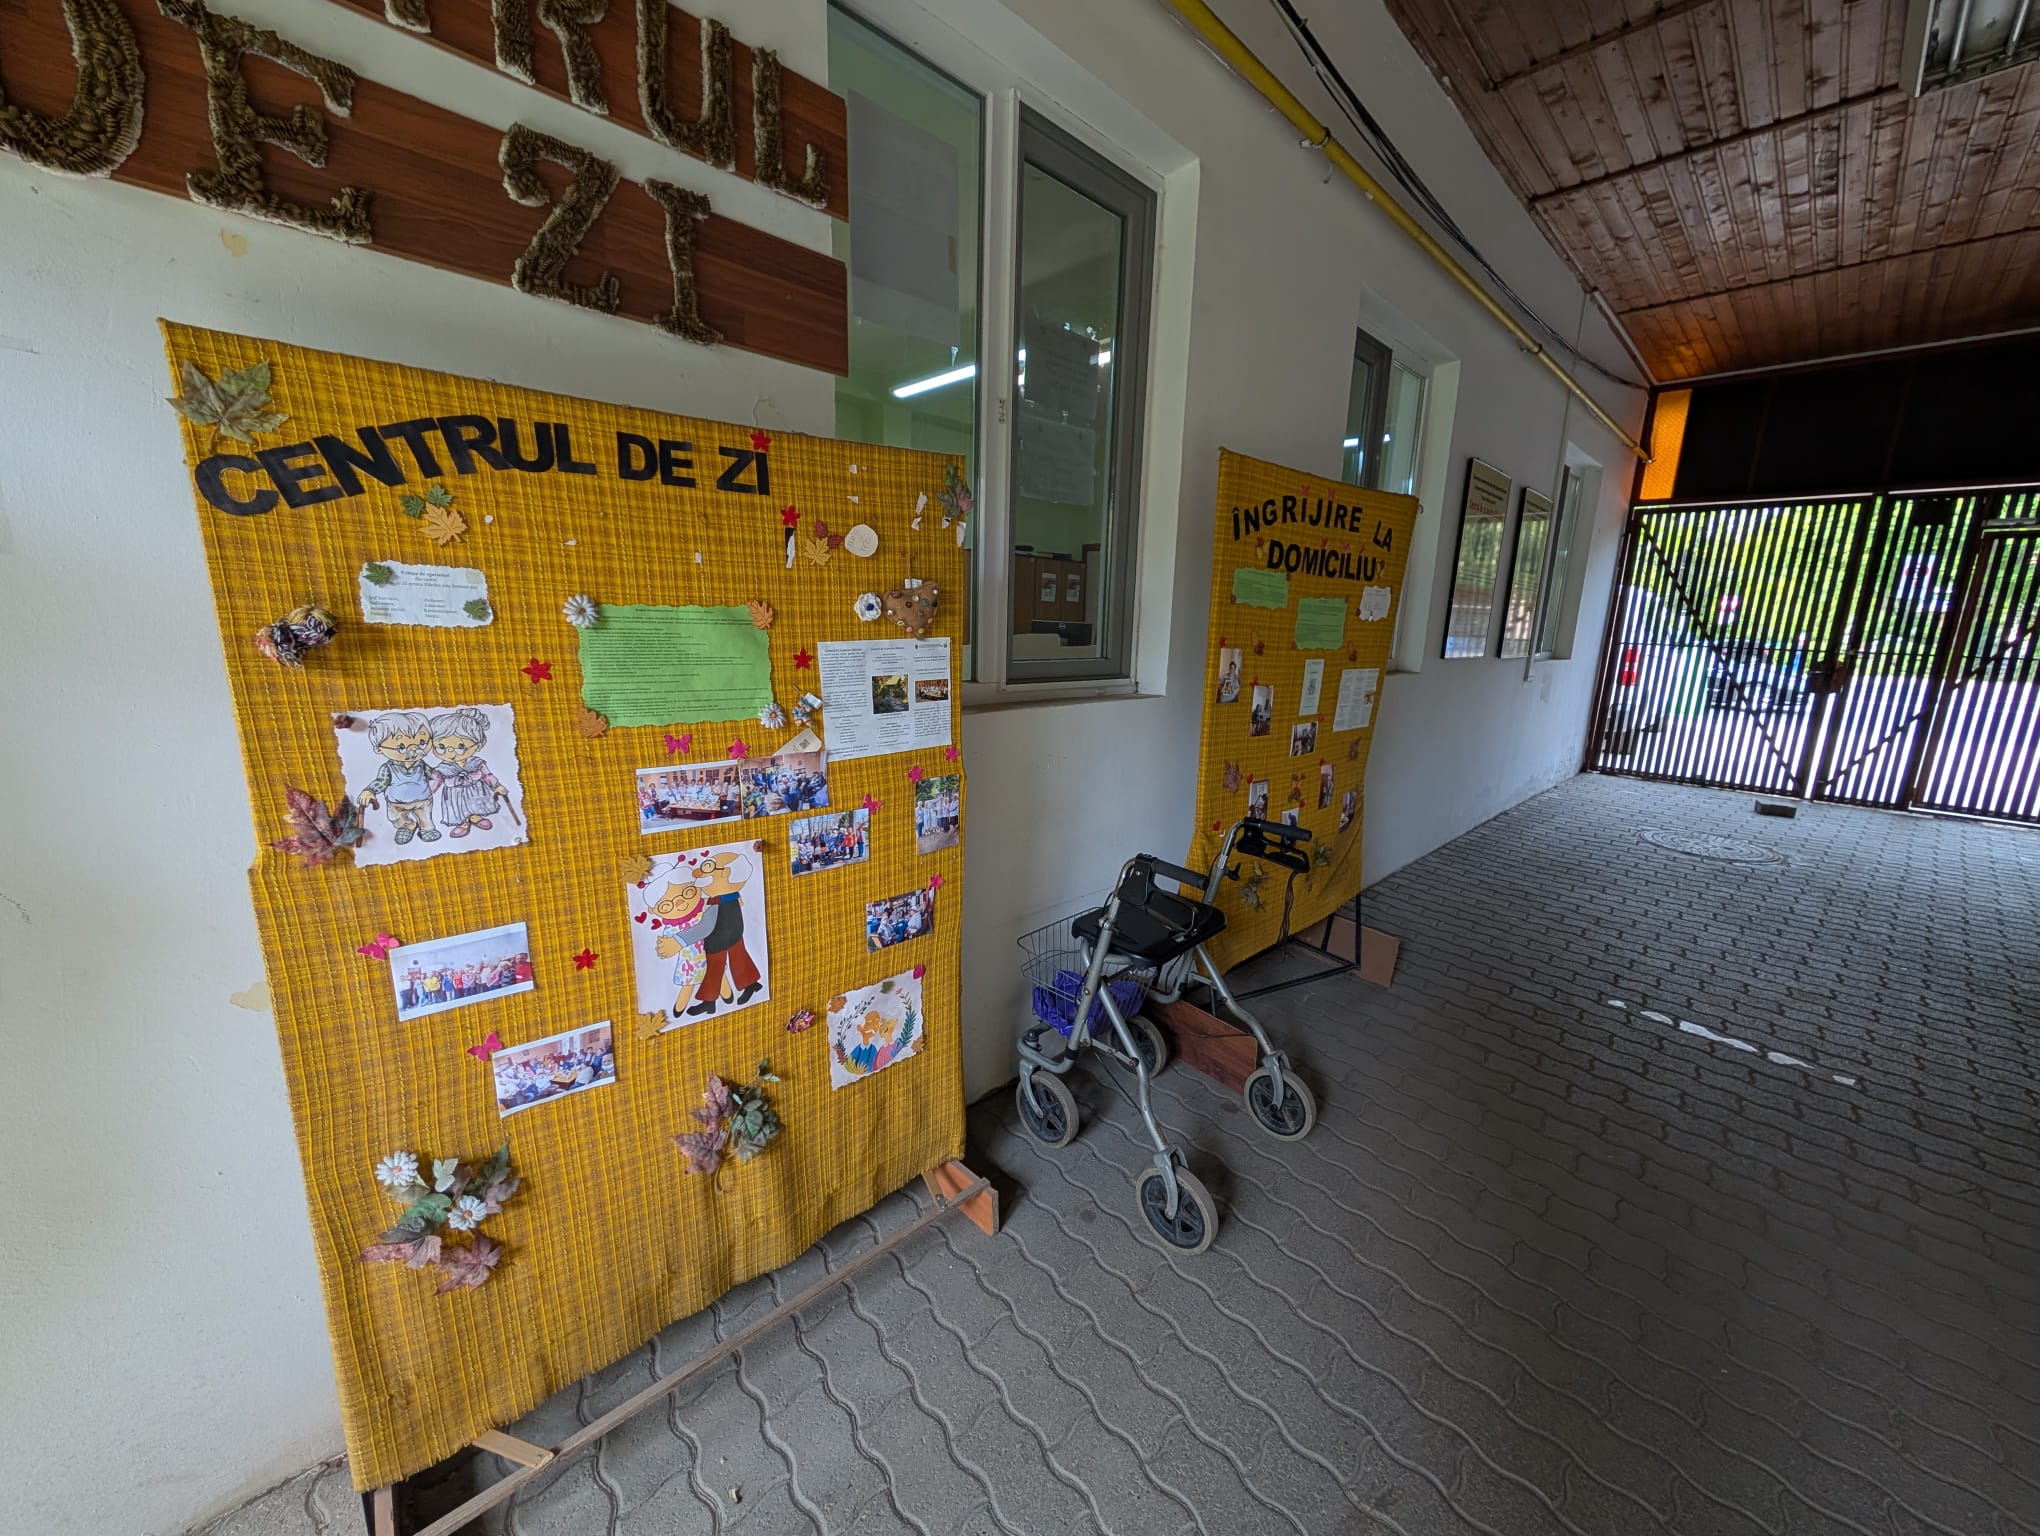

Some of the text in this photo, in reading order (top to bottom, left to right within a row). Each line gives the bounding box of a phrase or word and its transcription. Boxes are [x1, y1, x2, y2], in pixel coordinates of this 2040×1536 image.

[385, 0, 829, 209] RUL
[498, 121, 725, 347] ZI
[194, 414, 771, 516] CENTRUL DE ZI
[1232, 495, 1394, 552] ÎNGRIJIRE LA
[1266, 540, 1378, 582] DOMICILIU
